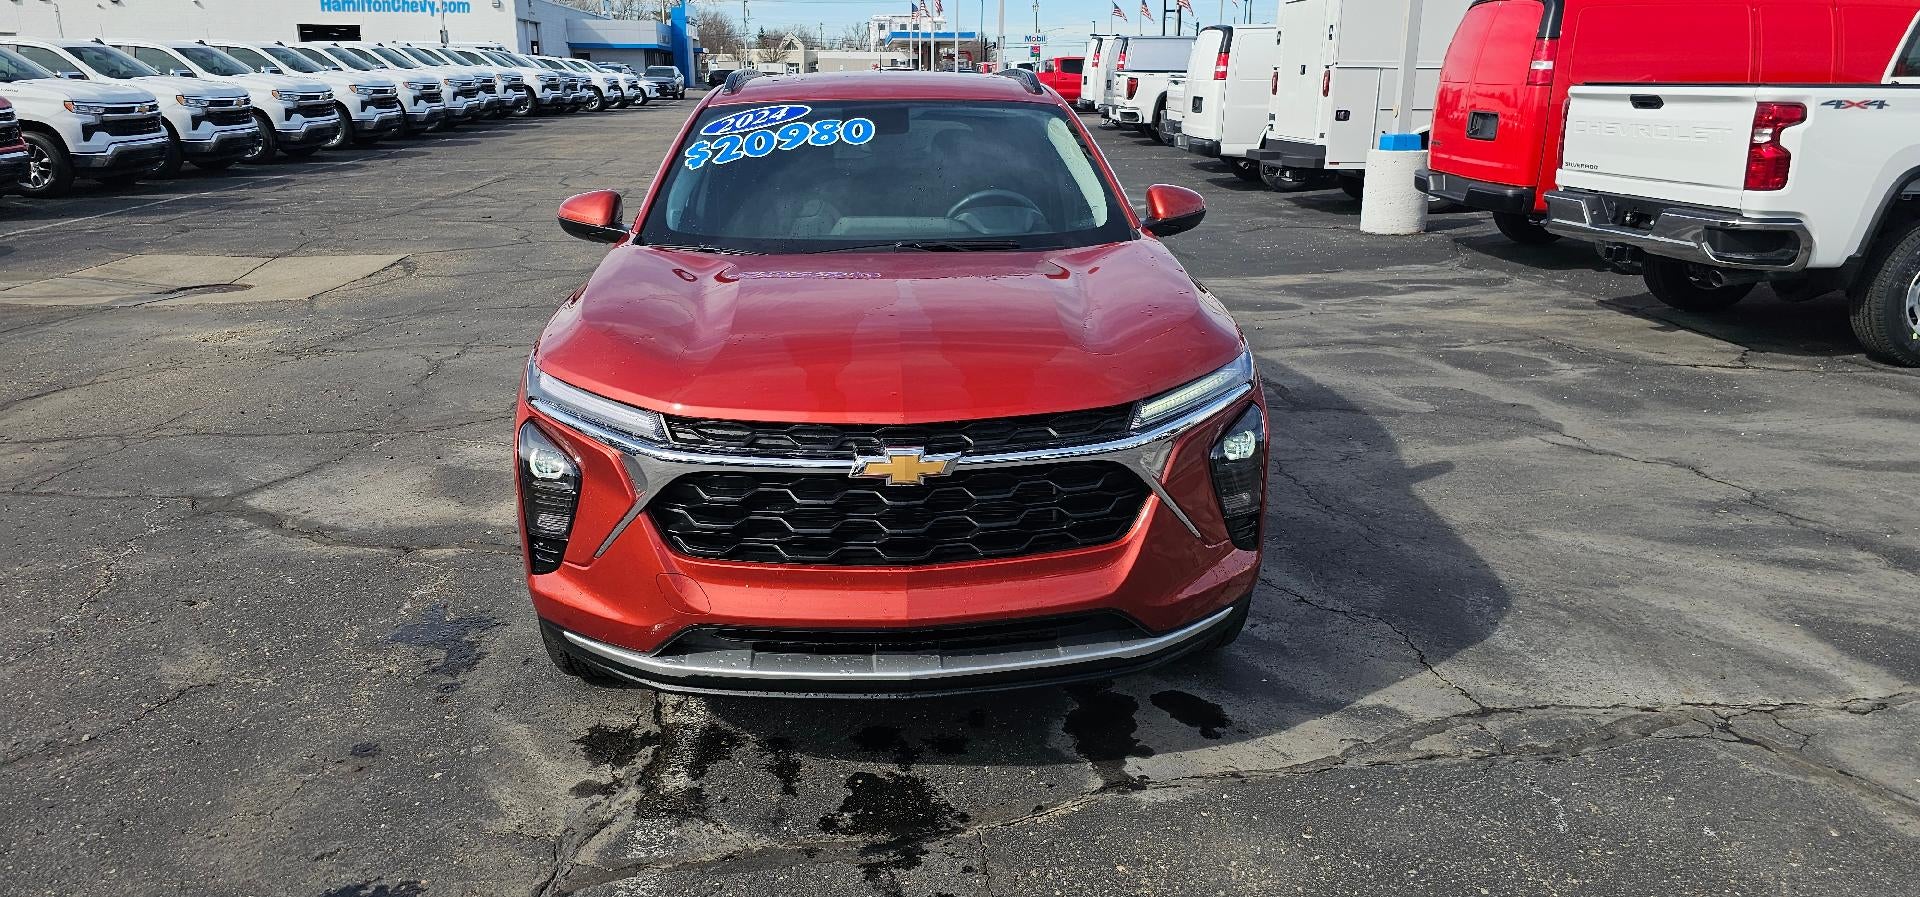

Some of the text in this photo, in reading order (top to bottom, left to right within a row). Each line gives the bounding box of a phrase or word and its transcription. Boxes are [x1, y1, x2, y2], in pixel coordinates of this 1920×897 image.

[320, 0, 471, 17] HamiltonChevy.com
[718, 105, 790, 133] 2024
[1574, 120, 1733, 143] CHEVROLET
[684, 117, 876, 171] $20980
